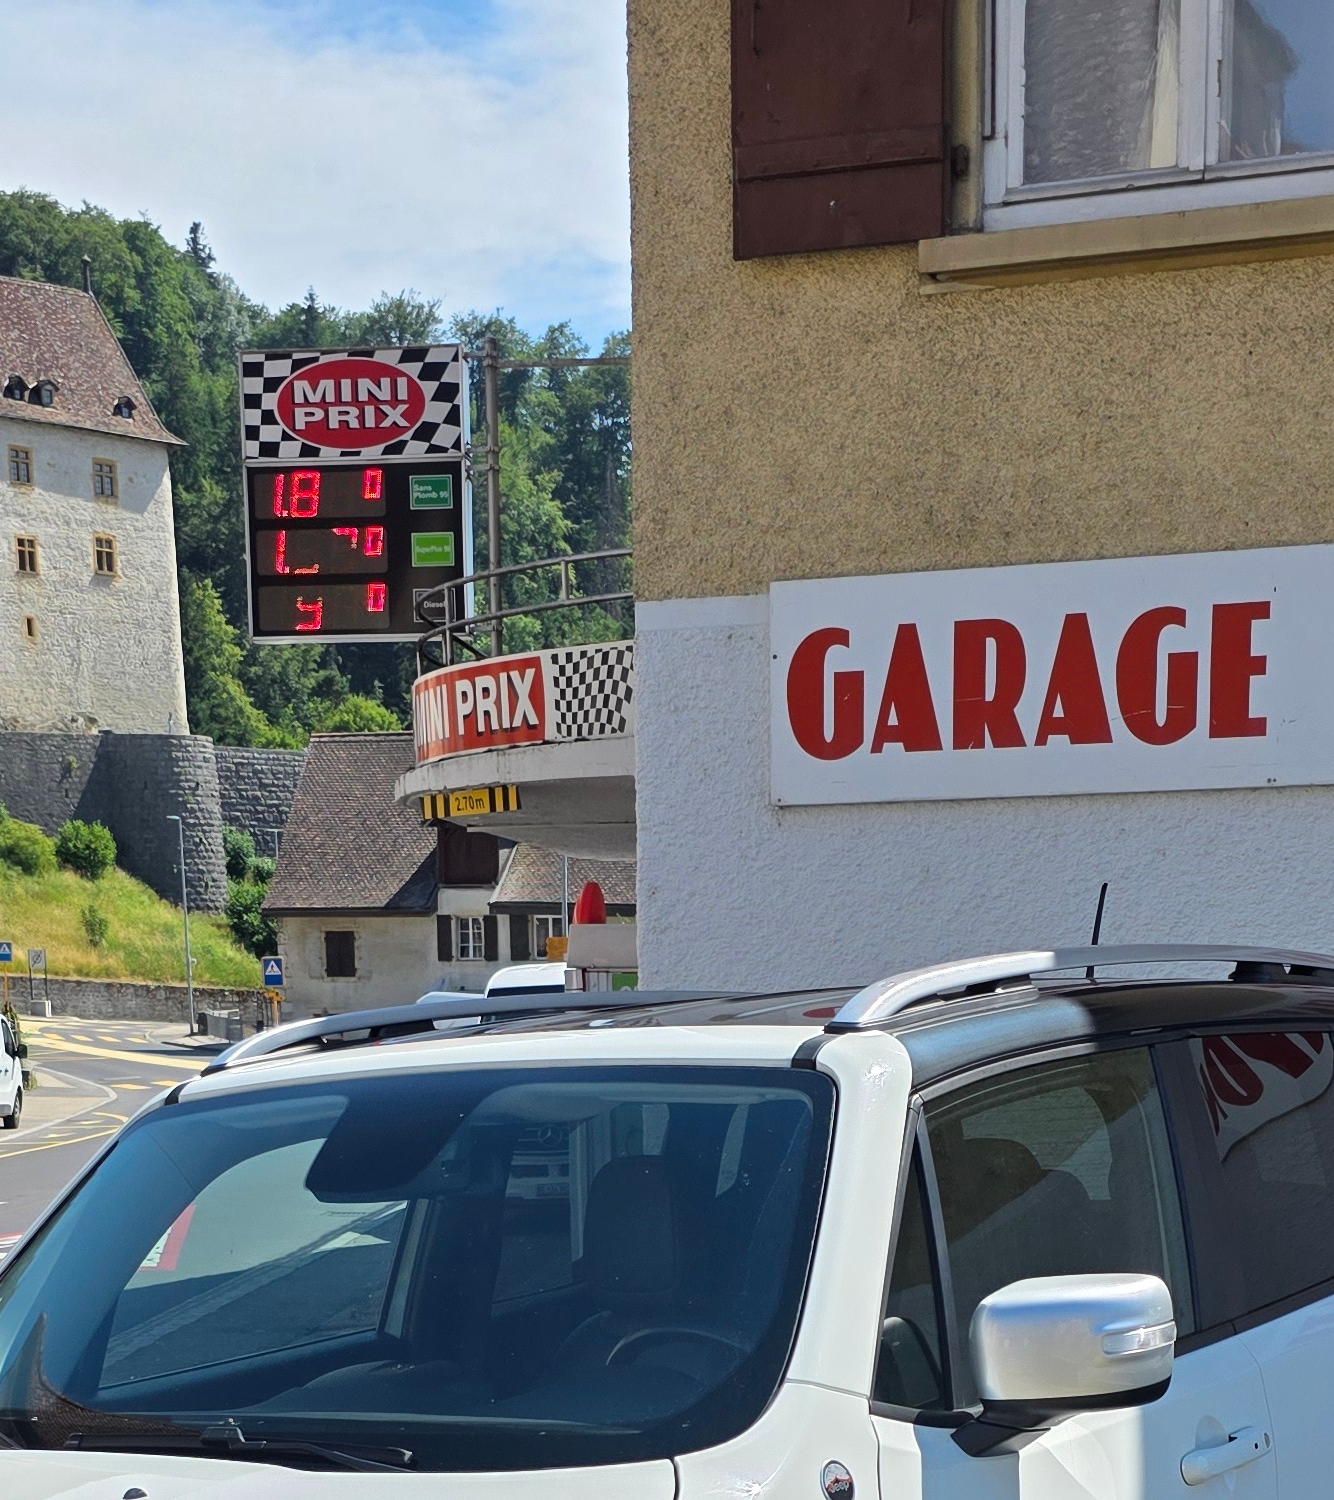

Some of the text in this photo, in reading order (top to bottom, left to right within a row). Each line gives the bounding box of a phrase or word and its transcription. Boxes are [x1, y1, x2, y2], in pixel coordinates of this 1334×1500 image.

[292, 376, 409, 404] MINI
[294, 404, 411, 431] PRIX
[423, 600, 446, 608] Diesel
[787, 602, 1269, 759] GARAGE
[416, 668, 540, 749] MINI PRIX
[454, 795, 485, 812] 2.70m
[826, 1481, 849, 1493] Jeep
